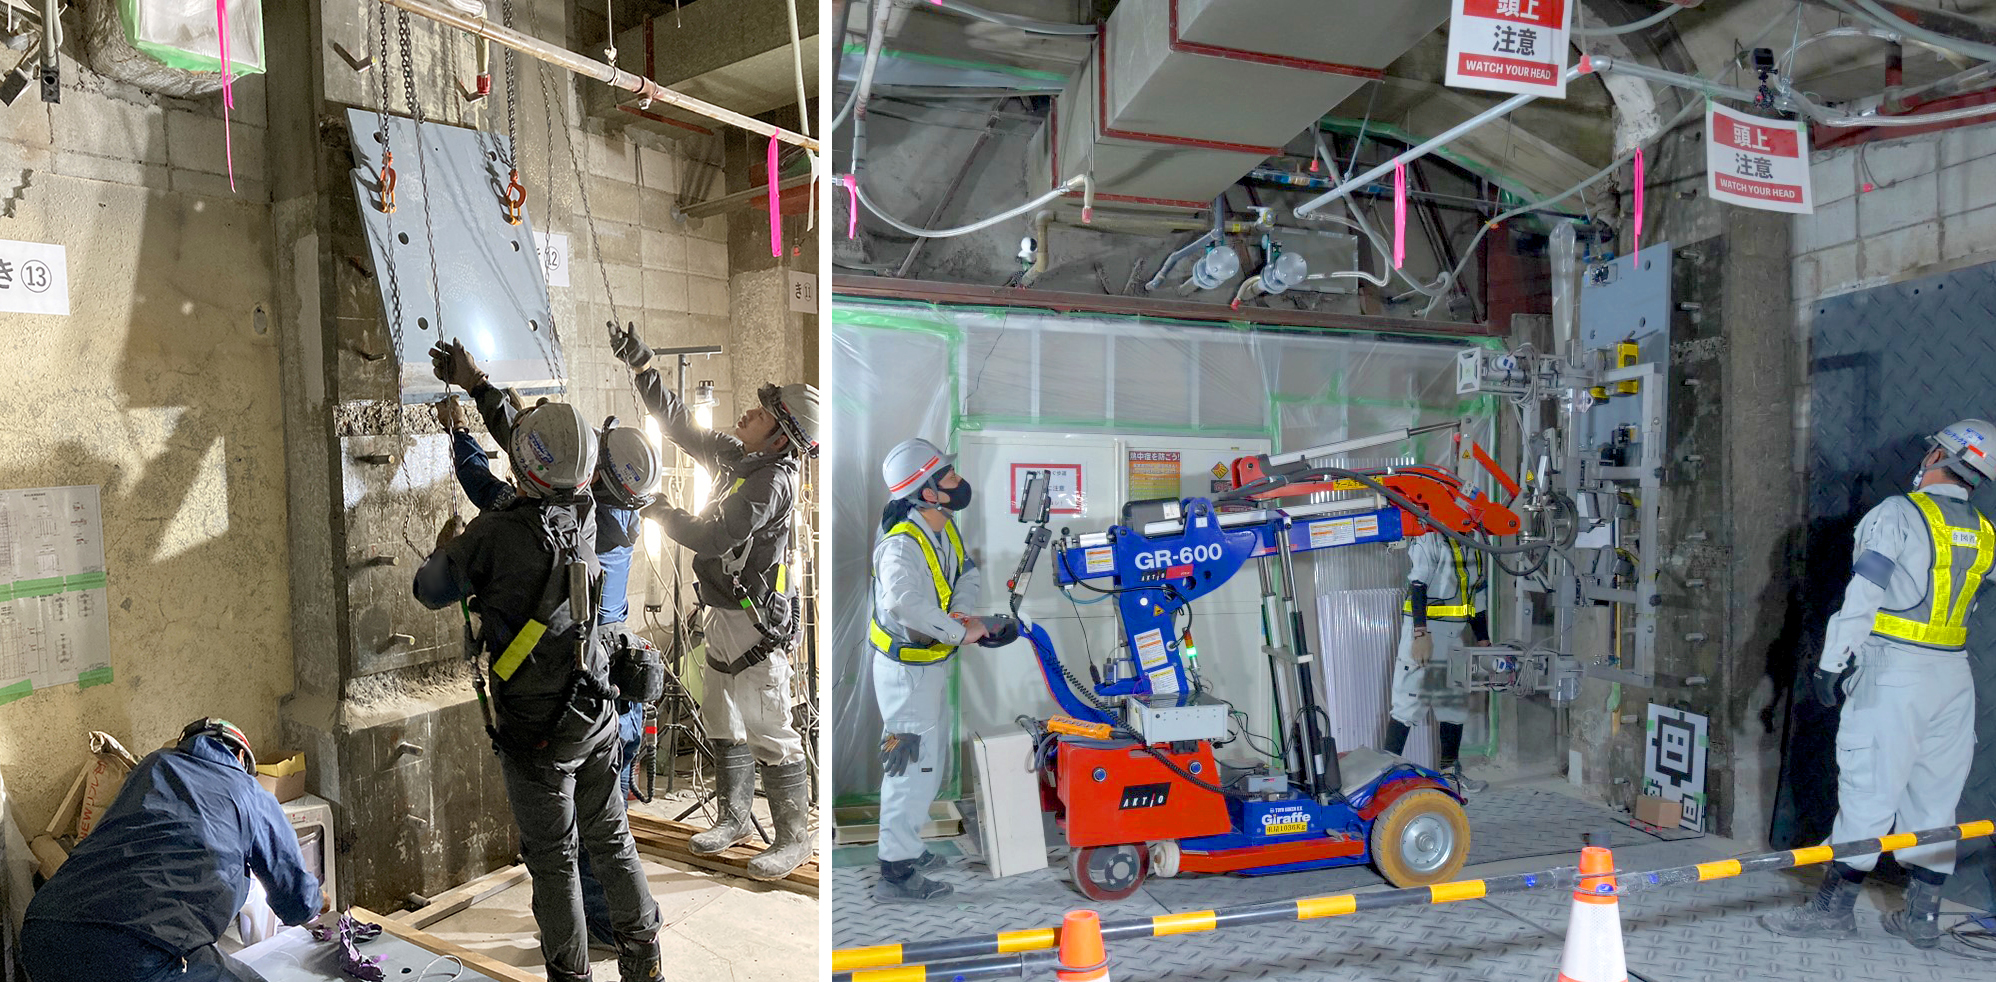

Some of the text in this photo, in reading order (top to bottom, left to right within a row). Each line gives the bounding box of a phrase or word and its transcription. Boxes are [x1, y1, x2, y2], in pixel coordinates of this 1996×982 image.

[1493, 25, 1537, 56] 注意
[1466, 60, 1551, 80] WATCH YOUR HEAD
[1733, 123, 1771, 151] 頭上
[1735, 153, 1773, 179] 注意
[1720, 179, 1795, 198] WATCH YOUR HEAD
[1134, 543, 1222, 570] GR-600
[1261, 811, 1311, 826] Giraffe
